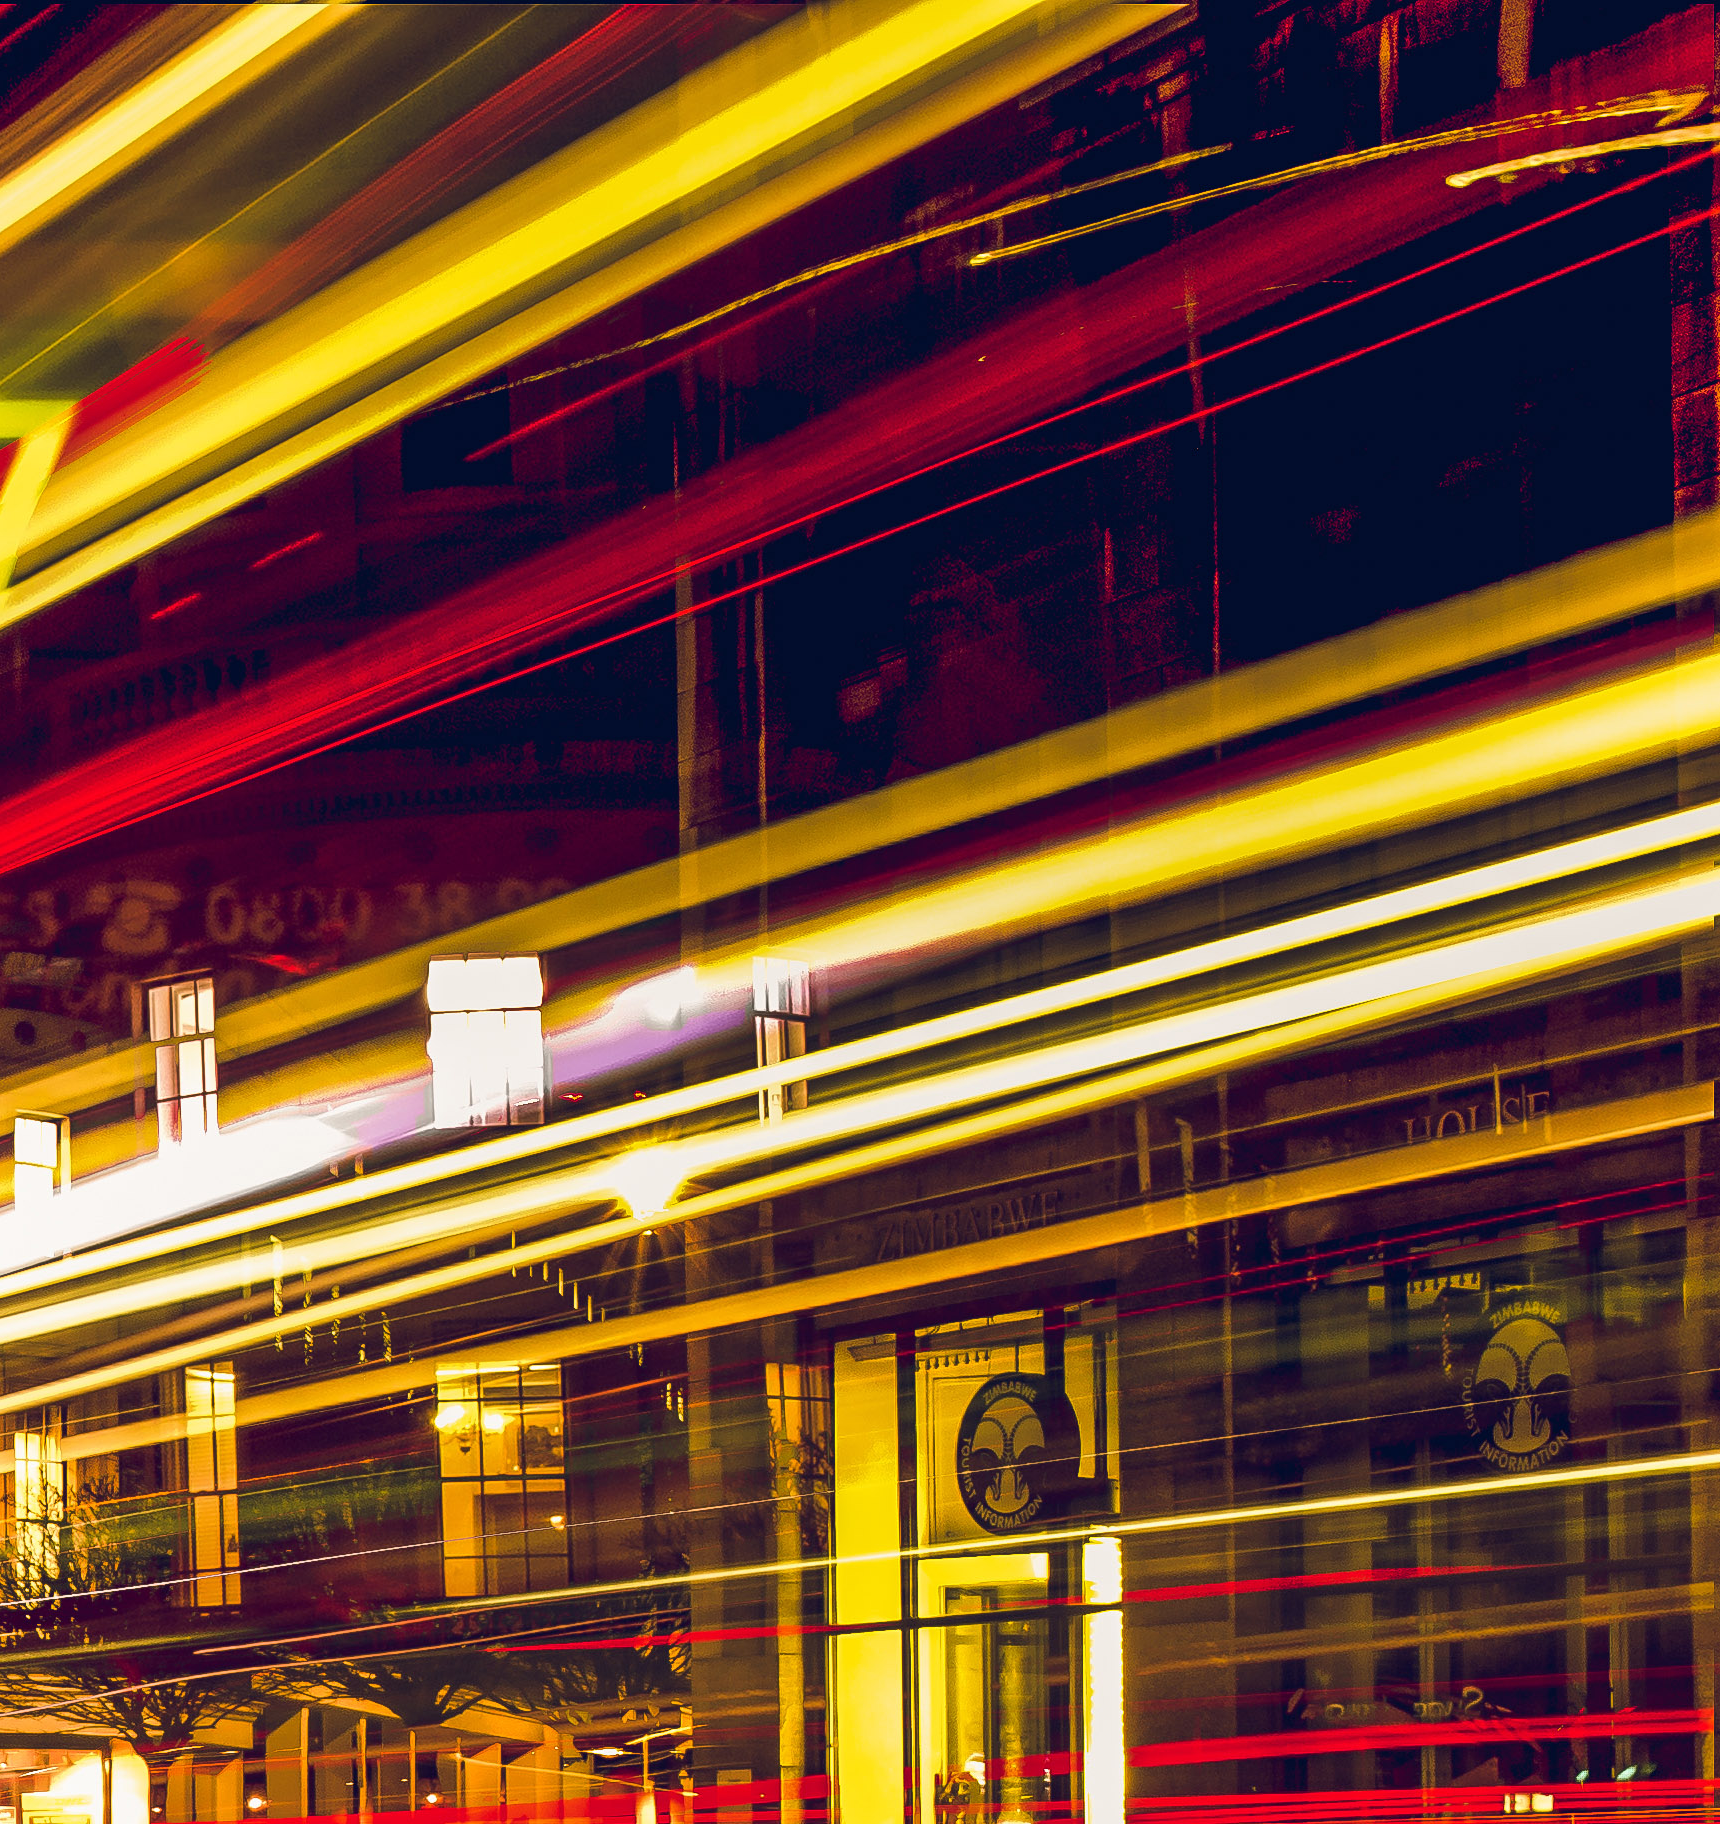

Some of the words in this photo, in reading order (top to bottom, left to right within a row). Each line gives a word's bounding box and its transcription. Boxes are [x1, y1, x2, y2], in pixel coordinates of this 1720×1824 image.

[876, 1190, 1058, 1263] ZIMBABWE
[1489, 1300, 1561, 1329] ZIMBABWE
[982, 1380, 1038, 1406] ZIMBABWE
[1461, 1367, 1481, 1438] TOURIST
[960, 1437, 977, 1499] TOURIST
[1478, 1429, 1569, 1472] INFORMATION
[974, 1494, 1043, 1529] INFORMATION
